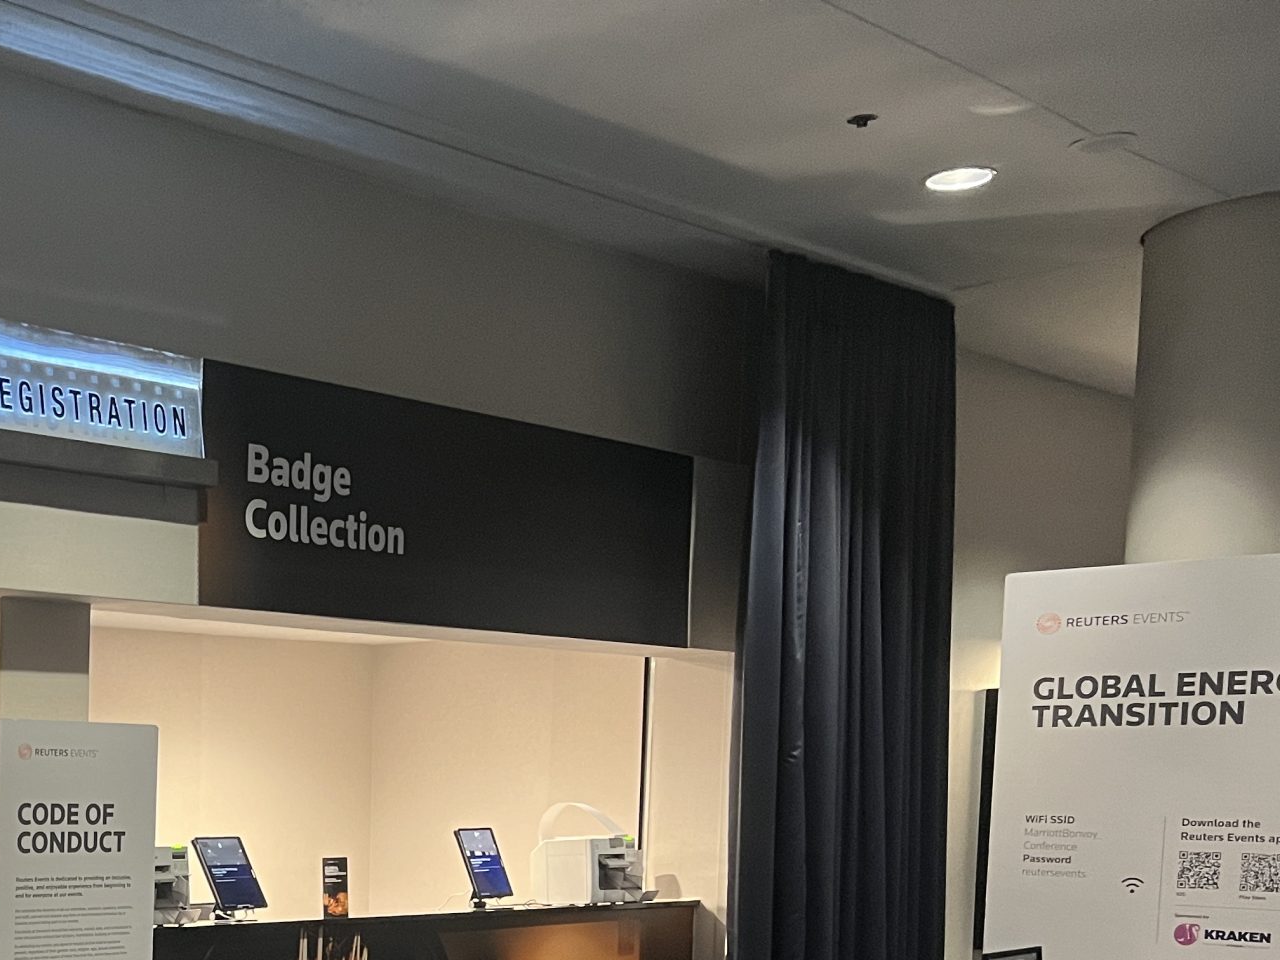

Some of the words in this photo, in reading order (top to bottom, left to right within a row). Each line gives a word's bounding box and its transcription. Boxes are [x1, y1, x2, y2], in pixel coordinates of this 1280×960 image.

[247, 443, 352, 503] Badge
[245, 498, 405, 555] Collection
[1066, 615, 1129, 628] REUTERS
[1033, 673, 1166, 700] GLOBAL
[1032, 700, 1245, 728] TRANSITION
[34, 748, 68, 758] REUTERS
[17, 802, 80, 826] CODE
[85, 803, 115, 826] OF
[1050, 815, 1075, 824] SSID
[1182, 818, 1239, 828] Download
[1242, 819, 1261, 828] the
[17, 831, 126, 854] CONDUCT
[1181, 832, 1224, 841] Reuters
[1227, 833, 1265, 843] Events
[1023, 854, 1072, 864] Password
[1204, 929, 1271, 943] KRAKEN
